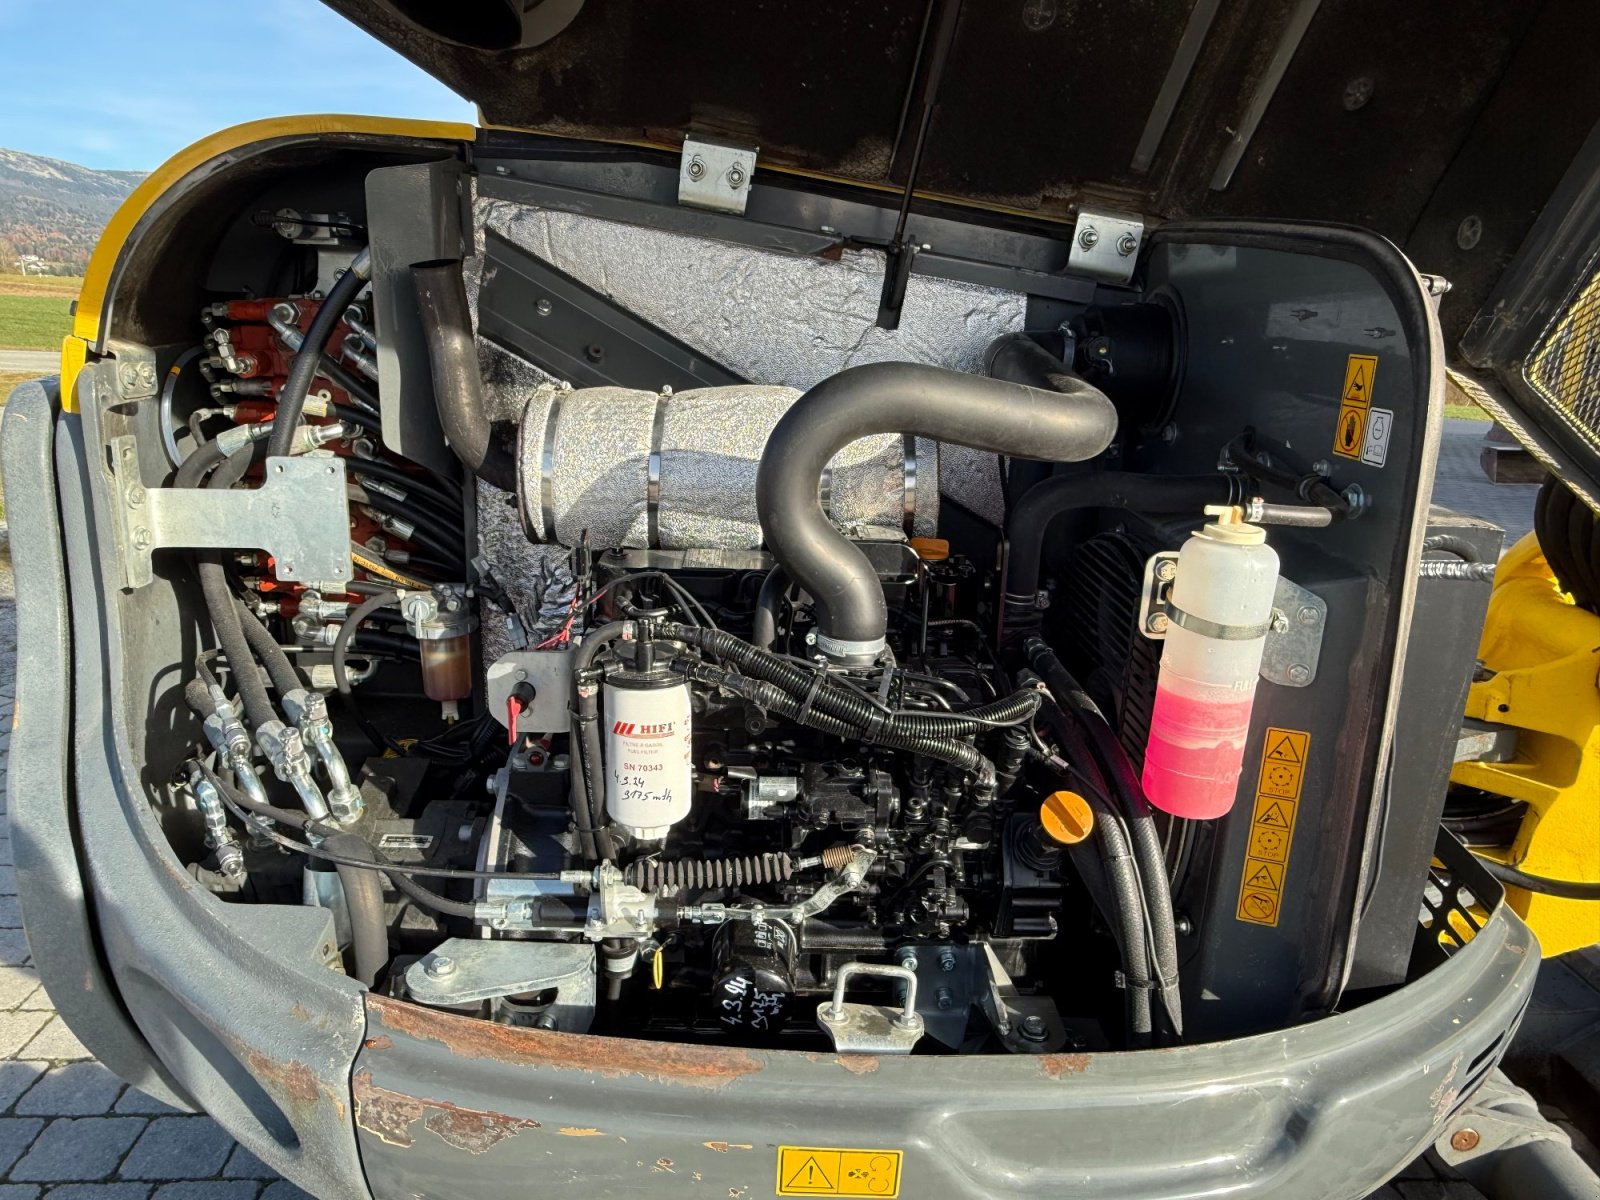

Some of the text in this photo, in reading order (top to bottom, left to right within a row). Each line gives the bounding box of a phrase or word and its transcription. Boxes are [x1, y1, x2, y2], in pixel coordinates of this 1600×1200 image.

[640, 722, 673, 733] HIFI
[624, 762, 664, 772] SN 70343
[1268, 787, 1290, 795] STOP
[1258, 849, 1280, 858] STOP
